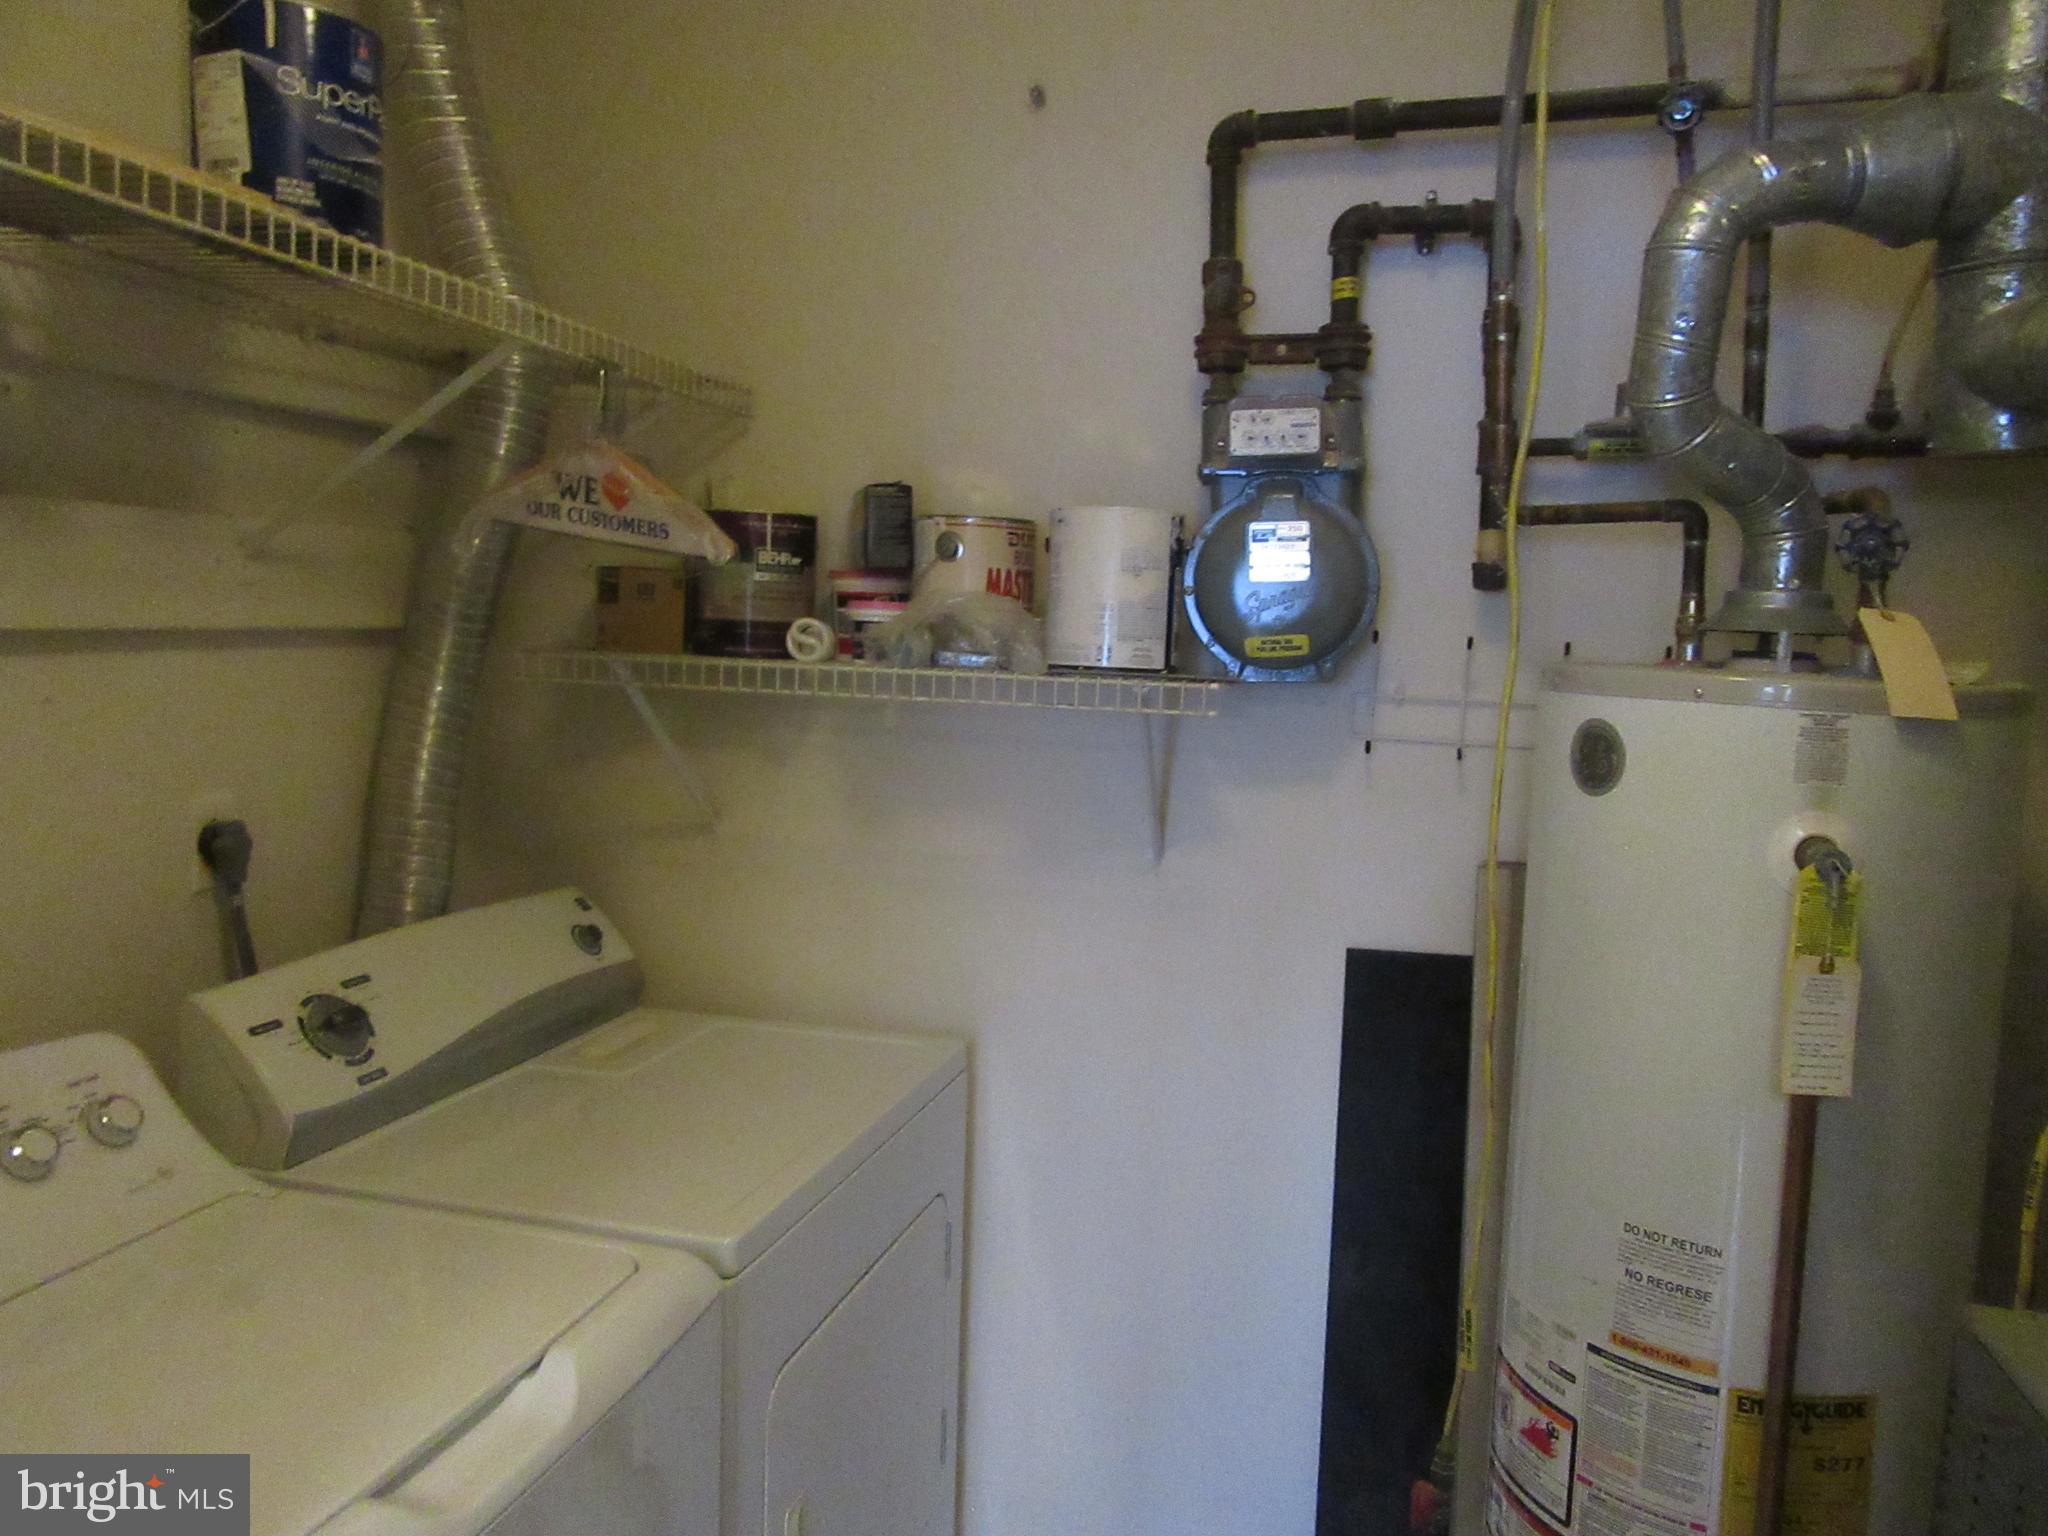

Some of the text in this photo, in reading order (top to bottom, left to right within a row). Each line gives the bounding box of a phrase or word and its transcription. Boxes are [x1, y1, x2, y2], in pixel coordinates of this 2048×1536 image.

[552, 471, 600, 505] WE
[526, 501, 670, 540] OUR CUSTOMERS
[1623, 1221, 1723, 1259] DO NOT RETURN
[1624, 1267, 1713, 1303] NO REGRESE
